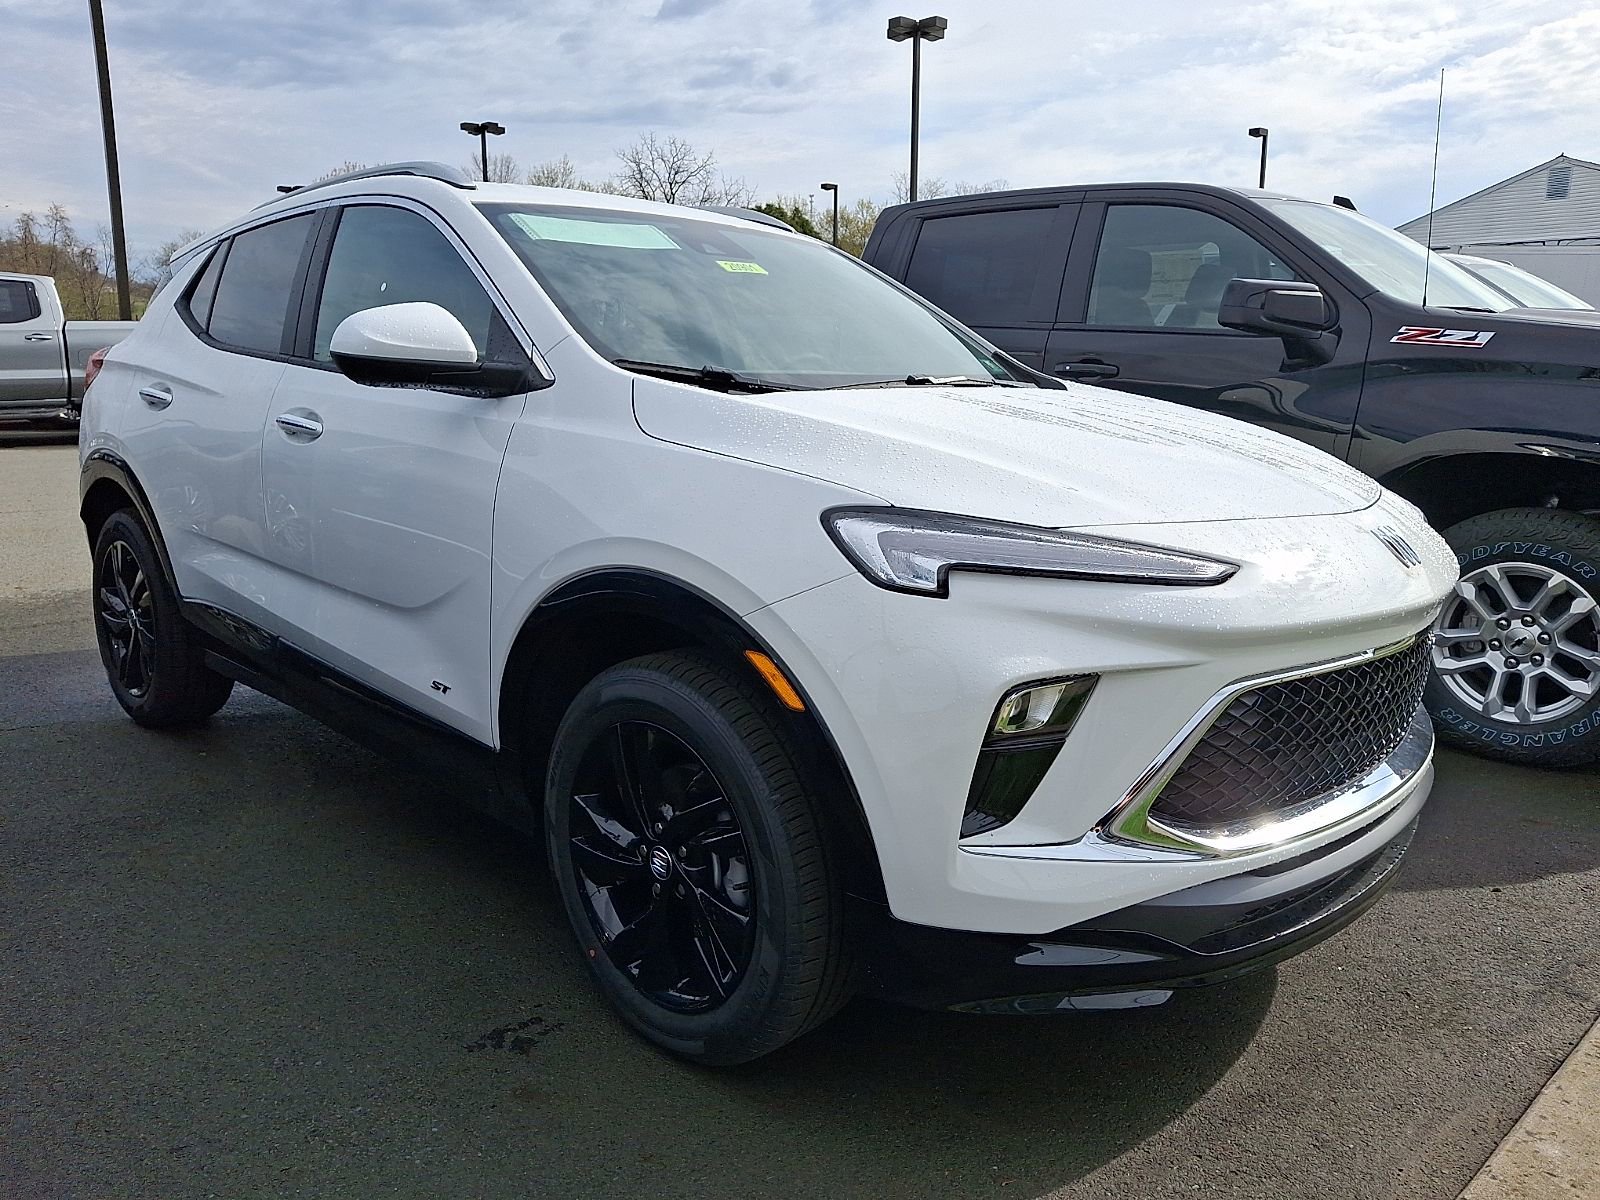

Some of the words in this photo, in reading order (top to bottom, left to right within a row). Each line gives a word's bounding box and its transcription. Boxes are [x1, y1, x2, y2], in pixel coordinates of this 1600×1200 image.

[1389, 326, 1496, 348] Z71
[1457, 541, 1597, 579] ODYEAR
[430, 680, 452, 695] ST
